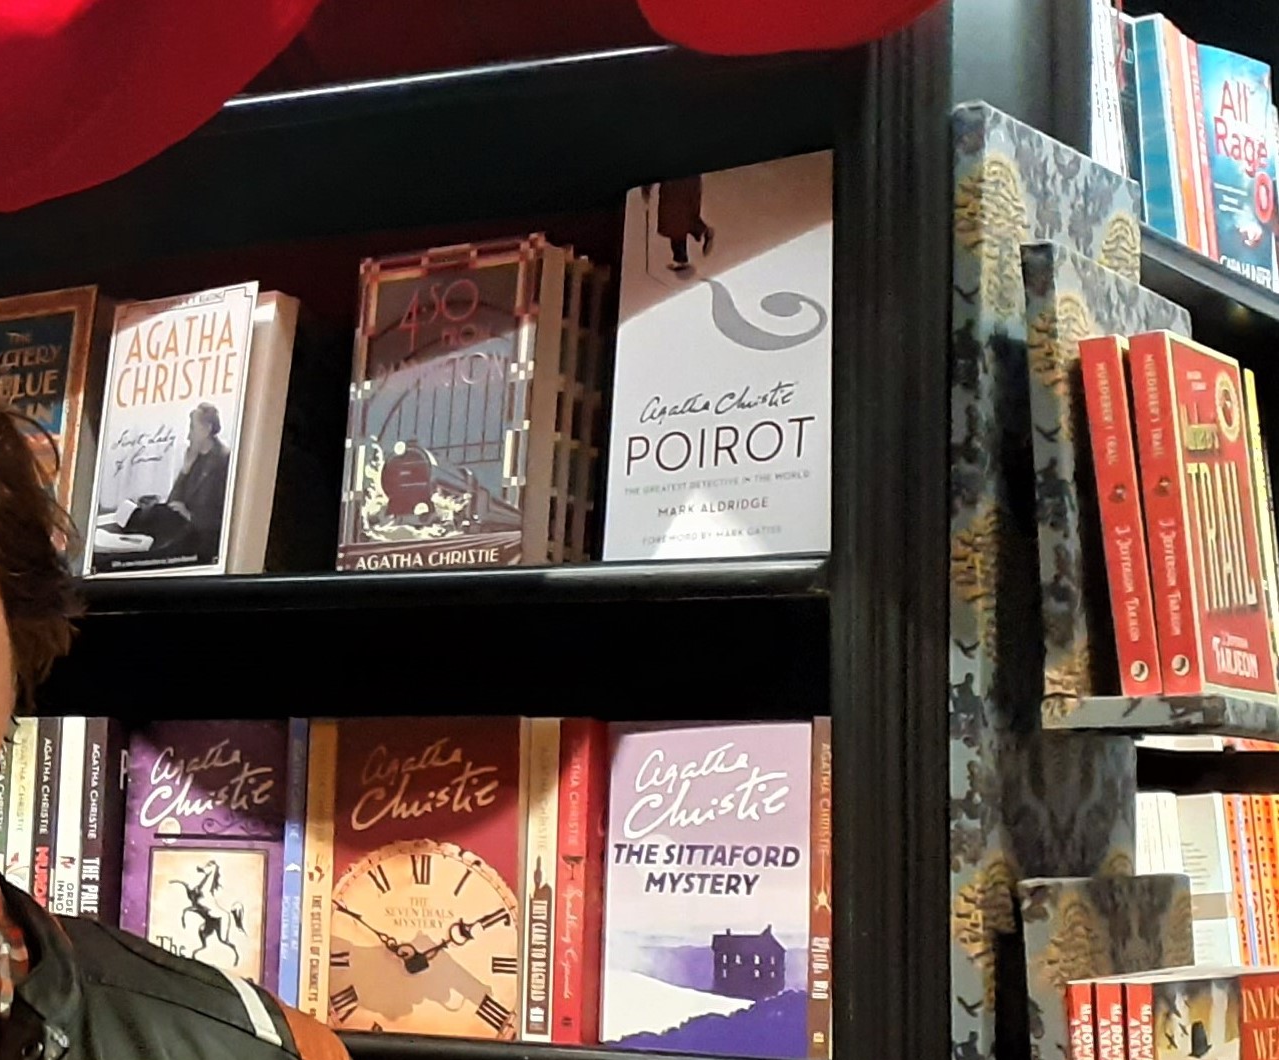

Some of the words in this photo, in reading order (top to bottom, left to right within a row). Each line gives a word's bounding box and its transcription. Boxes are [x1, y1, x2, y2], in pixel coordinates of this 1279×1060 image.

[1220, 80, 1249, 124] All
[1214, 116, 1267, 178] Rage
[124, 311, 234, 365] AGATHA
[115, 352, 238, 408] CHRISTIE
[639, 394, 712, 426] Agatha
[714, 380, 799, 416] Christie
[626, 415, 816, 476] POIROT
[657, 505, 694, 518] MARK
[700, 496, 770, 512] ALDRIDGE
[355, 552, 423, 571] AGATHA
[427, 548, 500, 566] CHRISTIE
[42, 737, 53, 783] AGATHA
[91, 743, 101, 788] AGATHA
[150, 738, 243, 785] Agatha
[360, 736, 463, 786] Agatha
[635, 742, 750, 797] Agatha
[38, 786, 51, 835] CHRISTIE
[86, 789, 100, 841] CHRISTIE
[138, 764, 275, 829] Christie
[350, 759, 500, 832] Christie
[568, 790, 580, 845] CHRISTIE
[621, 767, 791, 838] Christie
[81, 857, 101, 883] THE
[613, 844, 659, 867] THE
[661, 843, 802, 868] SITTAFORD
[80, 884, 100, 915] PALE
[644, 872, 762, 896] MYSTERY
[385, 907, 420, 918] SEVEN
[393, 919, 444, 930] MYSTERY
